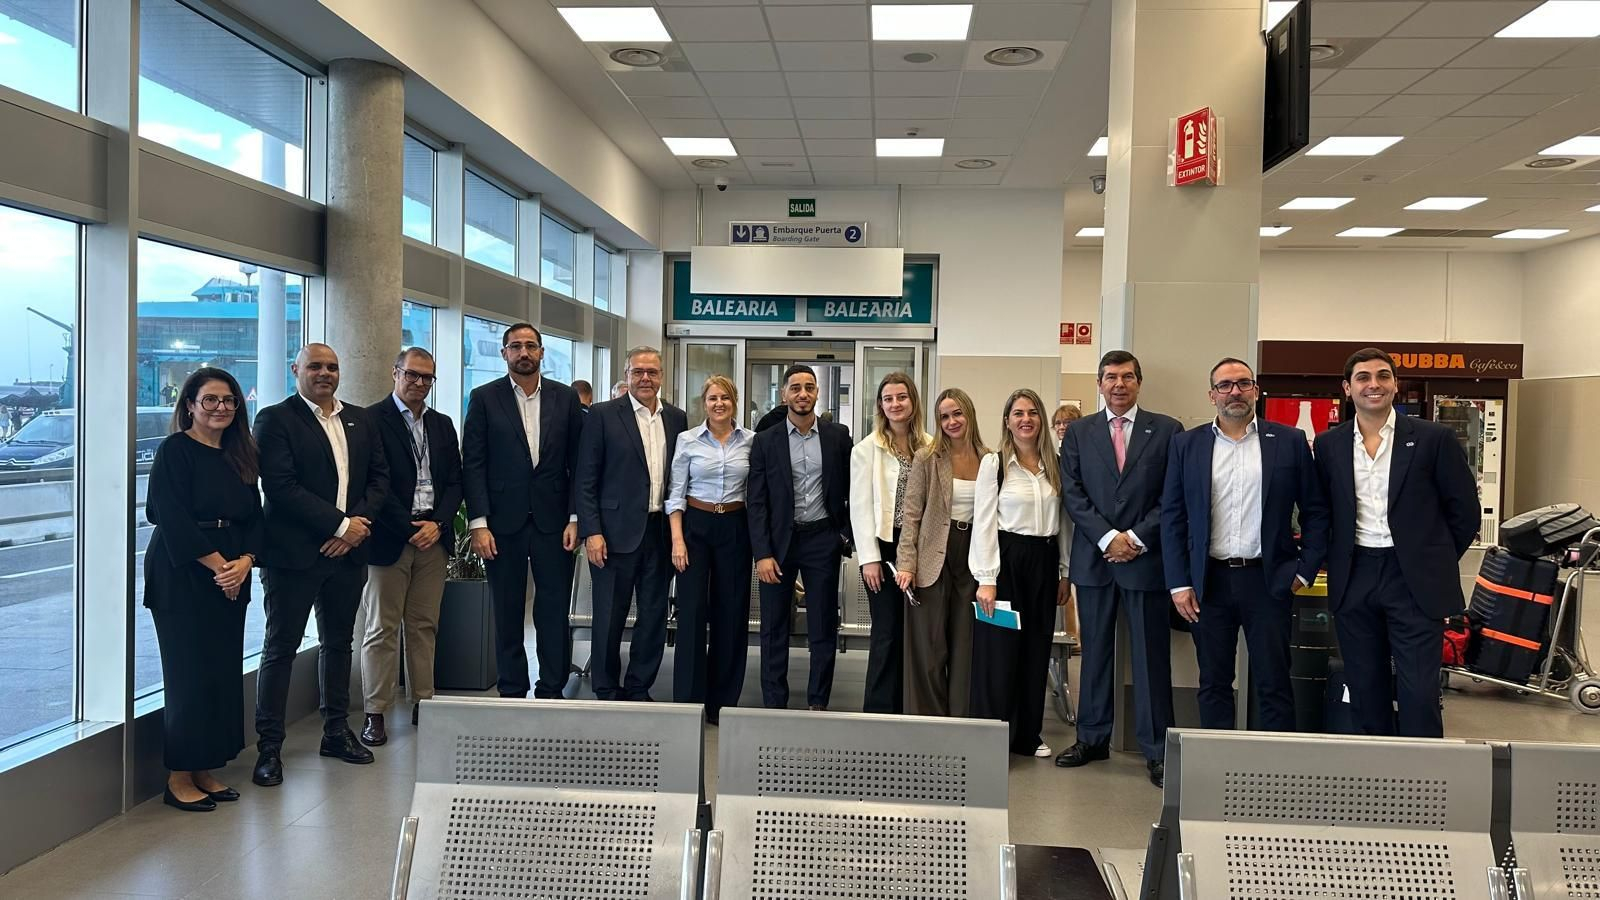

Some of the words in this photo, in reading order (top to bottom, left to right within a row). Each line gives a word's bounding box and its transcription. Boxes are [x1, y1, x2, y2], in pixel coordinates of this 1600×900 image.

[1178, 164, 1206, 179] EXTINTOR
[790, 203, 815, 213] SALIDA
[773, 226, 813, 235] Embarque
[815, 226, 842, 234] Puerta
[849, 229, 857, 240] 2
